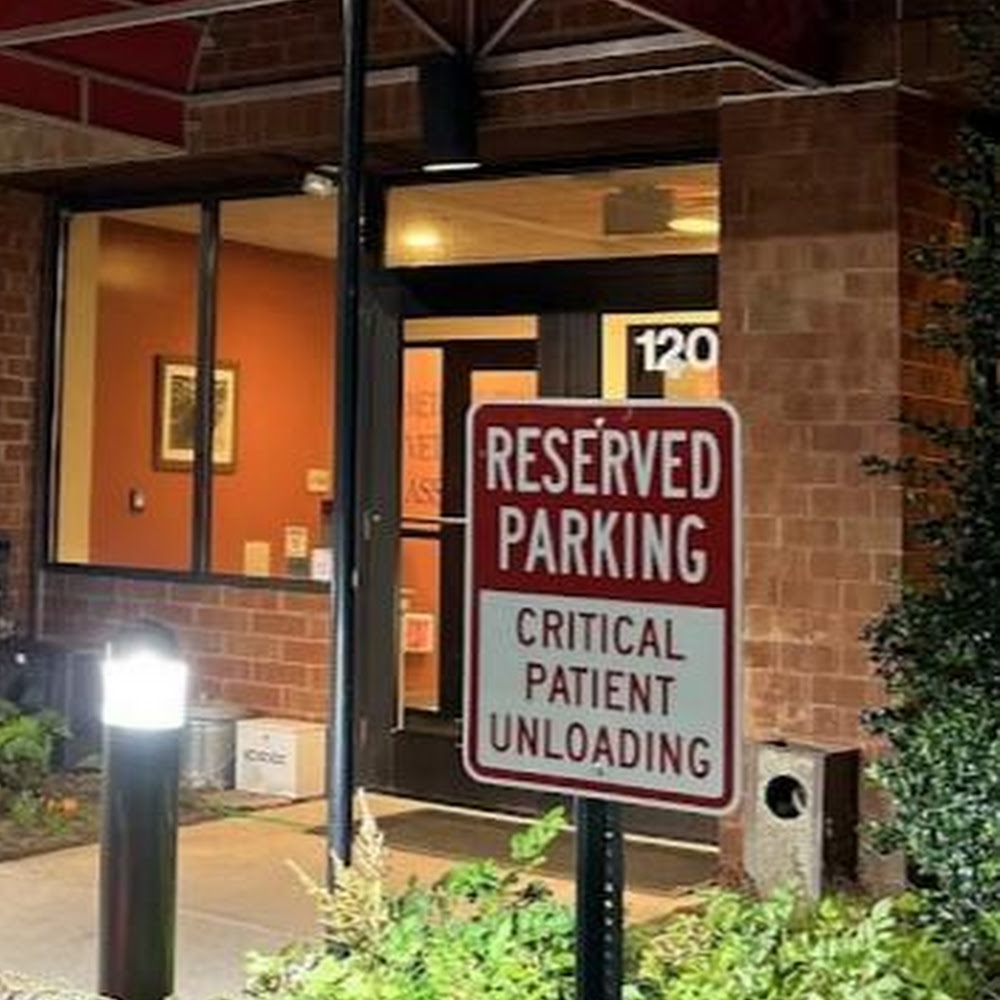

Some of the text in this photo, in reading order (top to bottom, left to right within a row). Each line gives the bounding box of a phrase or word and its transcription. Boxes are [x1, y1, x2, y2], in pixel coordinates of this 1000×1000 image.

[635, 326, 719, 371] 120
[485, 425, 721, 500] RESERVED
[499, 505, 708, 585] PARKING
[516, 607, 686, 662] CRITICAL
[526, 662, 676, 716] PATIENT
[491, 712, 711, 779] UNLOADING
